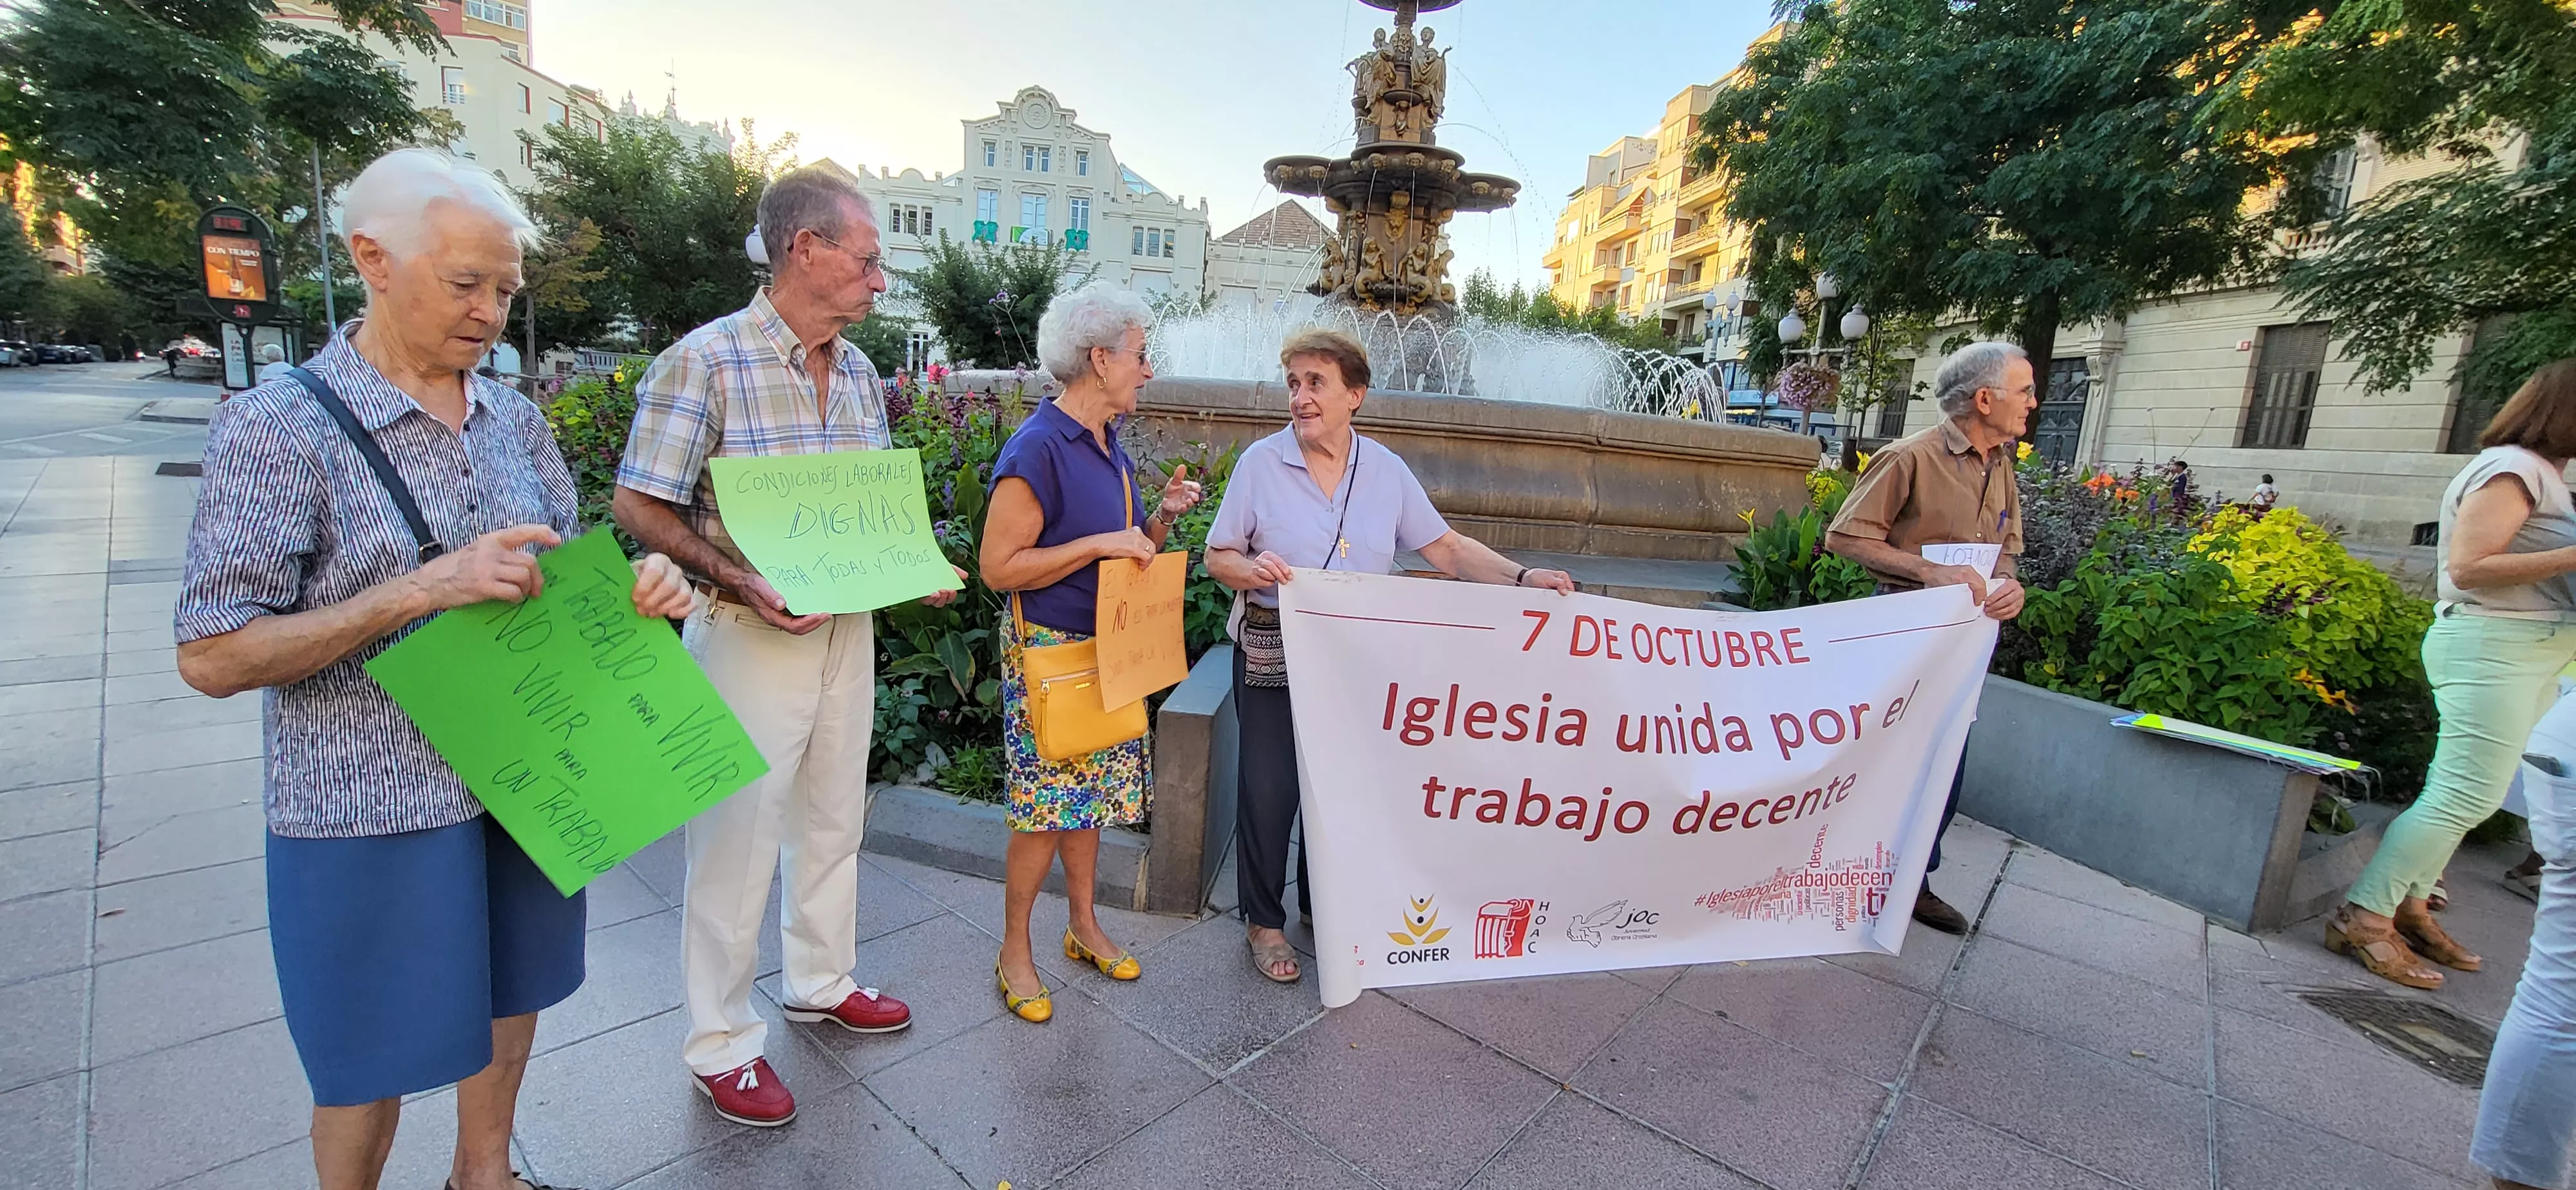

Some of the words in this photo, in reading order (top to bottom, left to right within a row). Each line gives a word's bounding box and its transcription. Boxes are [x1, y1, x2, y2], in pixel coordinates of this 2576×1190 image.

[736, 465, 838, 498] CONDICIONES
[846, 460, 913, 488] LABORALES
[784, 491, 915, 539] DIGNAS
[766, 565, 814, 589] PARA
[812, 551, 867, 585] TODAS
[879, 544, 931, 567] TODOS
[486, 598, 553, 653] NO
[1112, 599, 1128, 634] NO
[1520, 610, 1550, 653] 7
[1569, 615, 1623, 660] DE
[1631, 622, 1811, 668] OCTUBRE
[513, 662, 590, 742] VIVIR
[562, 566, 658, 681] TRABAJO
[628, 693, 661, 728] PARA
[656, 704, 741, 802] VIVIR
[1382, 682, 1588, 747] Iglesia
[1615, 702, 1753, 754] unida
[1770, 703, 1870, 760] por
[1882, 679, 1921, 728] el
[554, 748, 587, 782] PARA
[491, 759, 538, 794] UN
[533, 775, 621, 874] TRABAJO
[1421, 776, 1650, 842] trabajo
[1672, 772, 1858, 835] decente
[1806, 823, 1829, 869] decente
[1694, 867, 1896, 909] #Iglesiaporeltrabajodecen
[1835, 891, 1846, 931] personas
[1844, 887, 1859, 923] dignidad
[1387, 947, 1450, 965] CONFER
